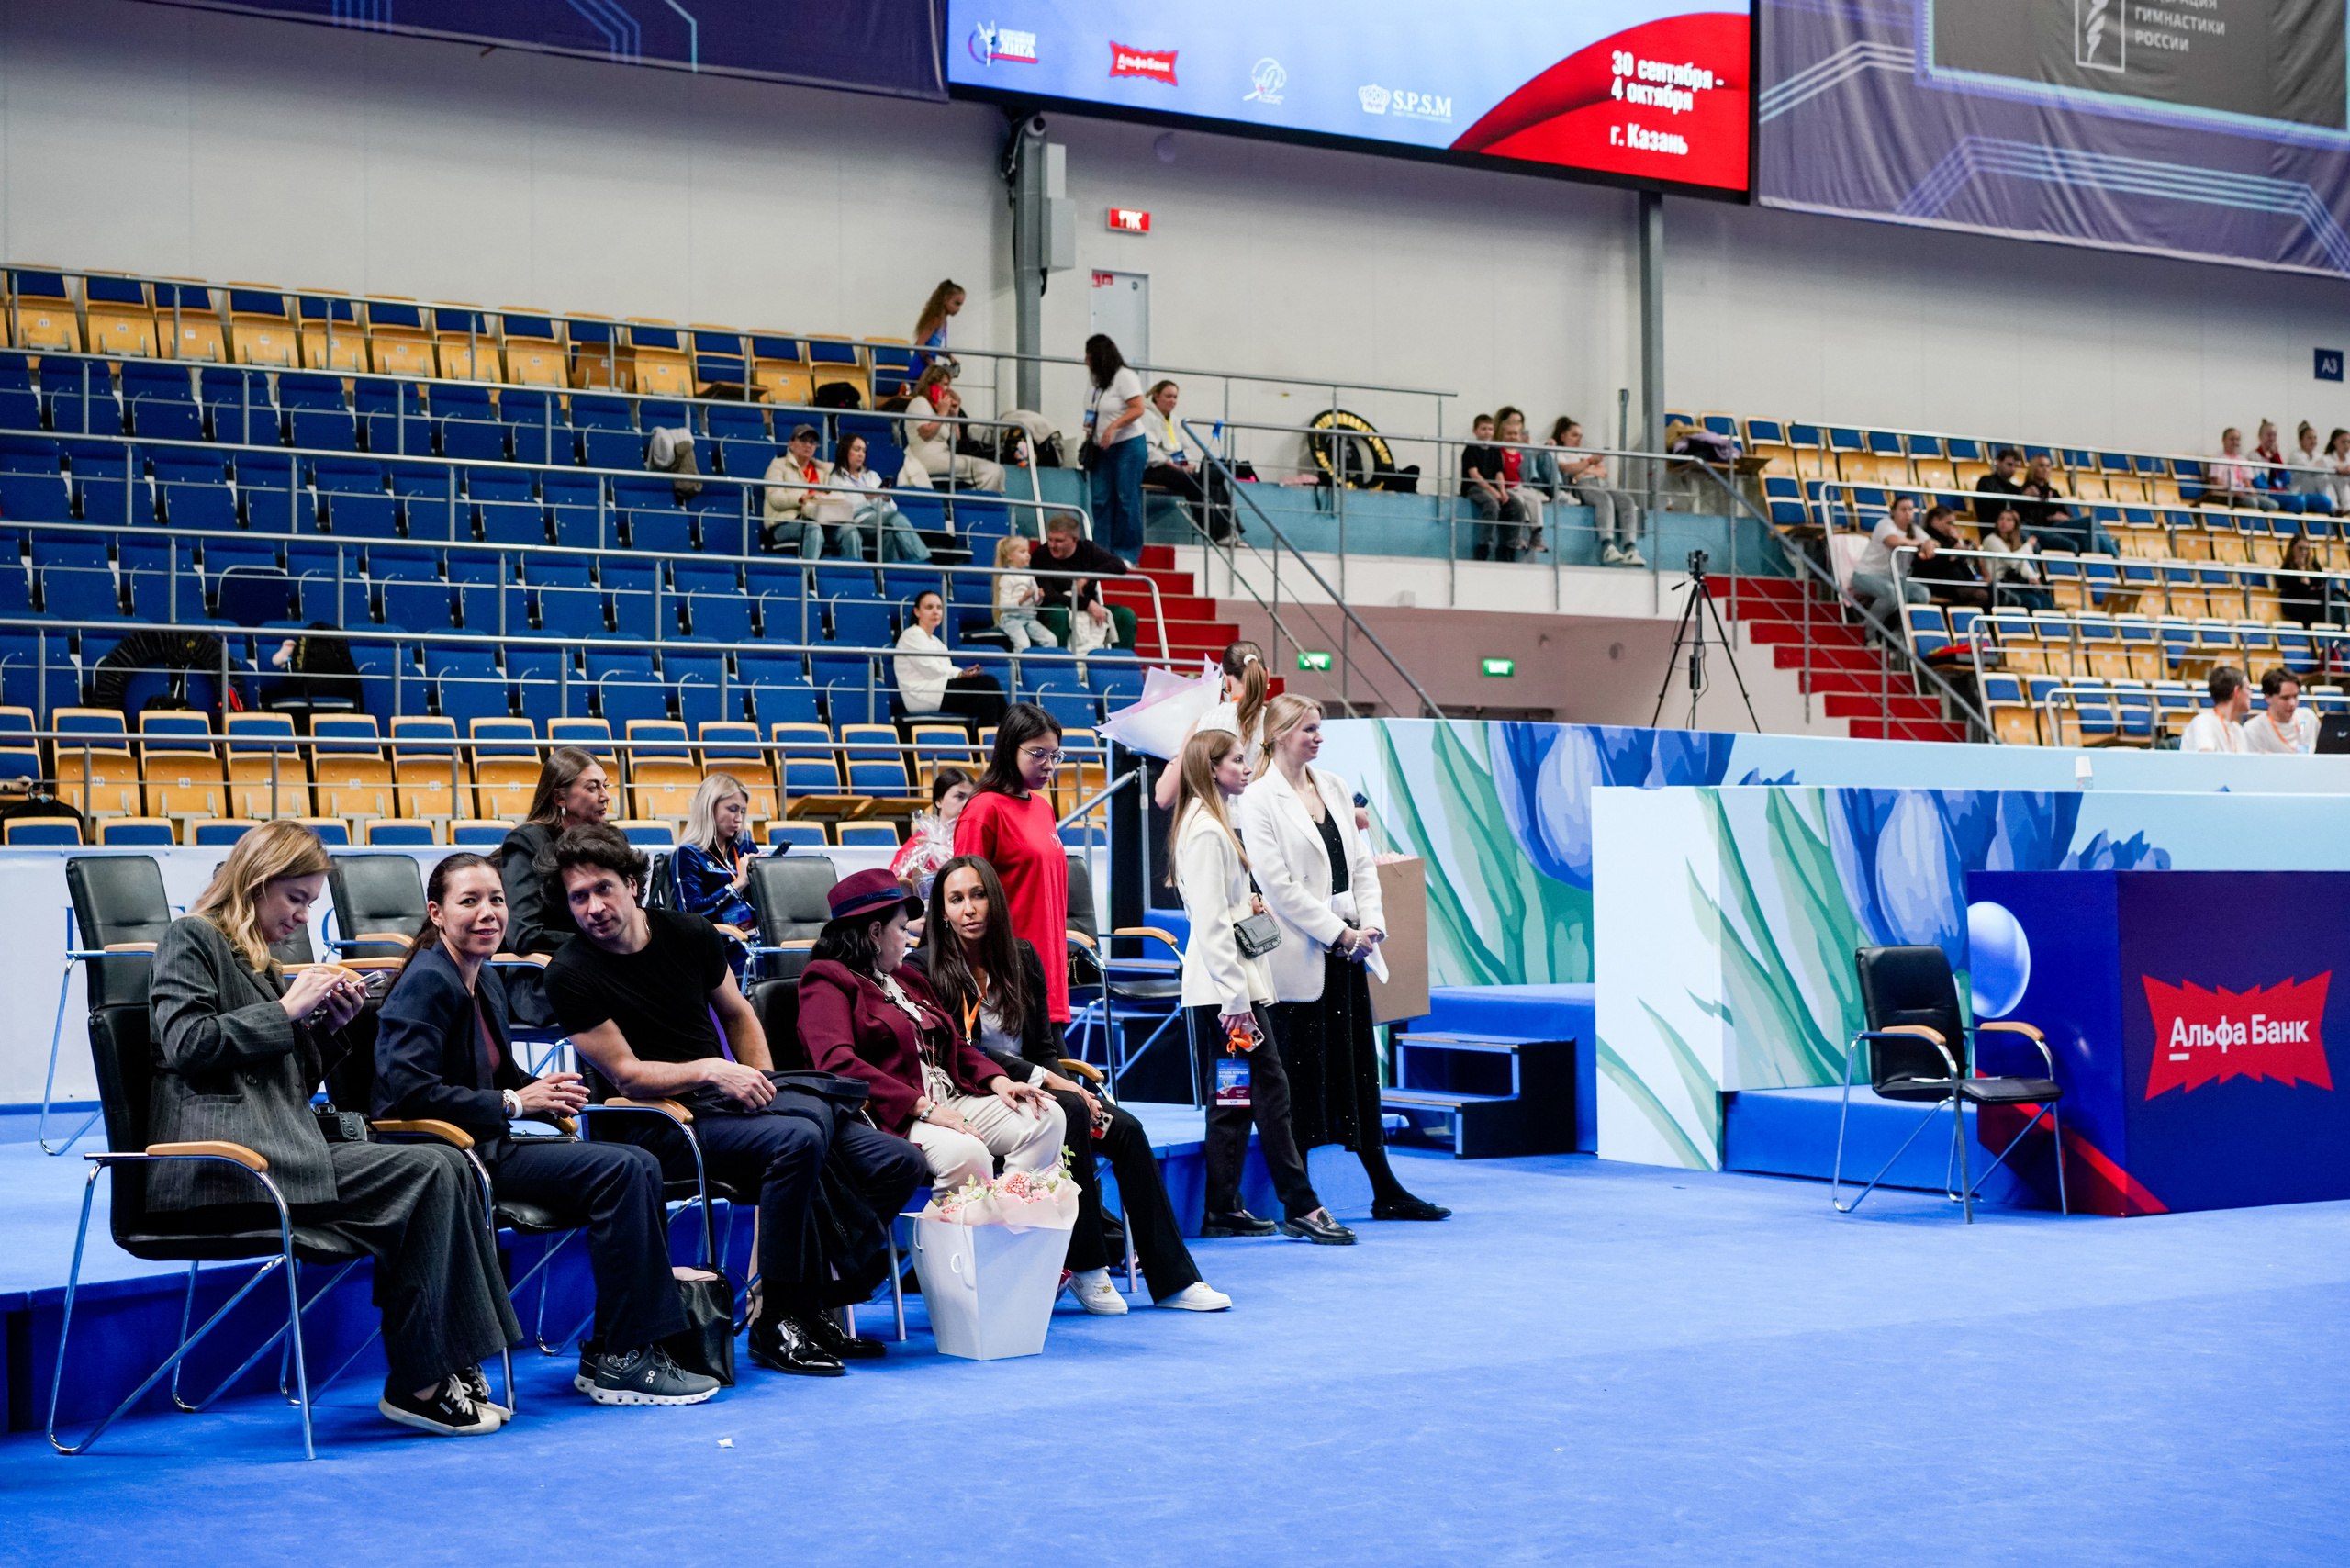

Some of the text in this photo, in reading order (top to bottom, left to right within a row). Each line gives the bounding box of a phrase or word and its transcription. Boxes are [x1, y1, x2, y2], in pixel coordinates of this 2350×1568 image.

[2134, 6, 2225, 36] ГИМНАСТИКИ
[2134, 29, 2189, 52] РОССИИ
[1611, 50, 1634, 77] 30
[1637, 59, 1713, 93] сентября
[1611, 76, 1694, 115] 4 октября
[1610, 122, 1689, 155] г. Казань
[2169, 1014, 2310, 1056] Альфа Банк
